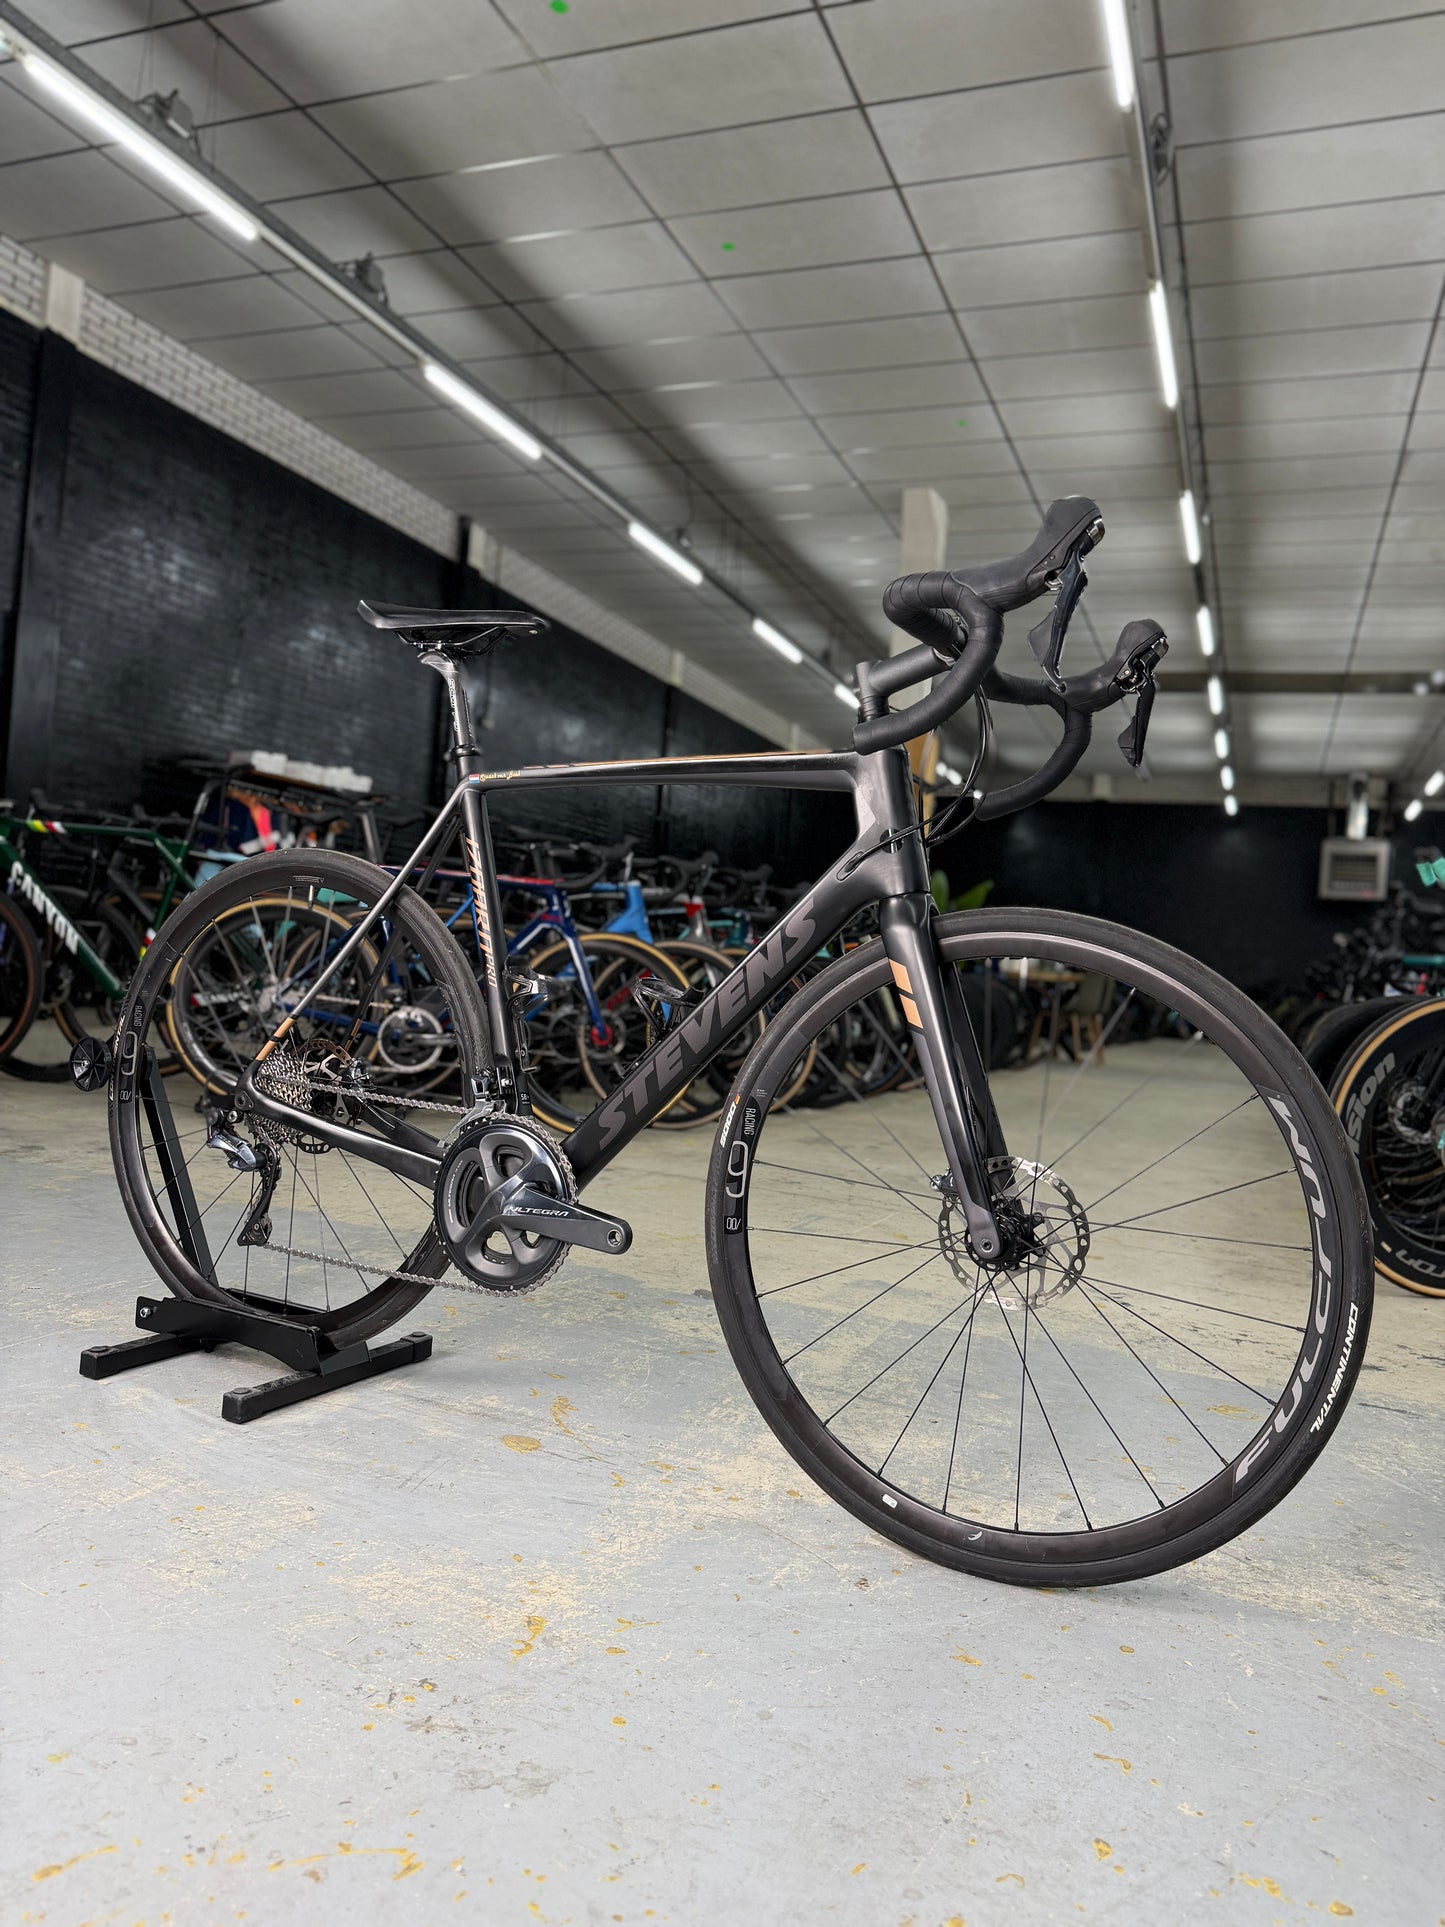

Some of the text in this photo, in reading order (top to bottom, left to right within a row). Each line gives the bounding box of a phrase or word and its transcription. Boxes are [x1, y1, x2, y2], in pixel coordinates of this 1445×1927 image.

[10, 861, 79, 955] CANYON
[485, 953, 498, 988] PRO
[133, 1005, 143, 1027] RACING
[598, 897, 816, 1150] STEVENS
[744, 1107, 757, 1136] RACING
[1347, 1052, 1396, 1155] ision
[505, 1206, 569, 1217] ULTEGRA
[1310, 1301, 1360, 1433] CONTINENTAL
